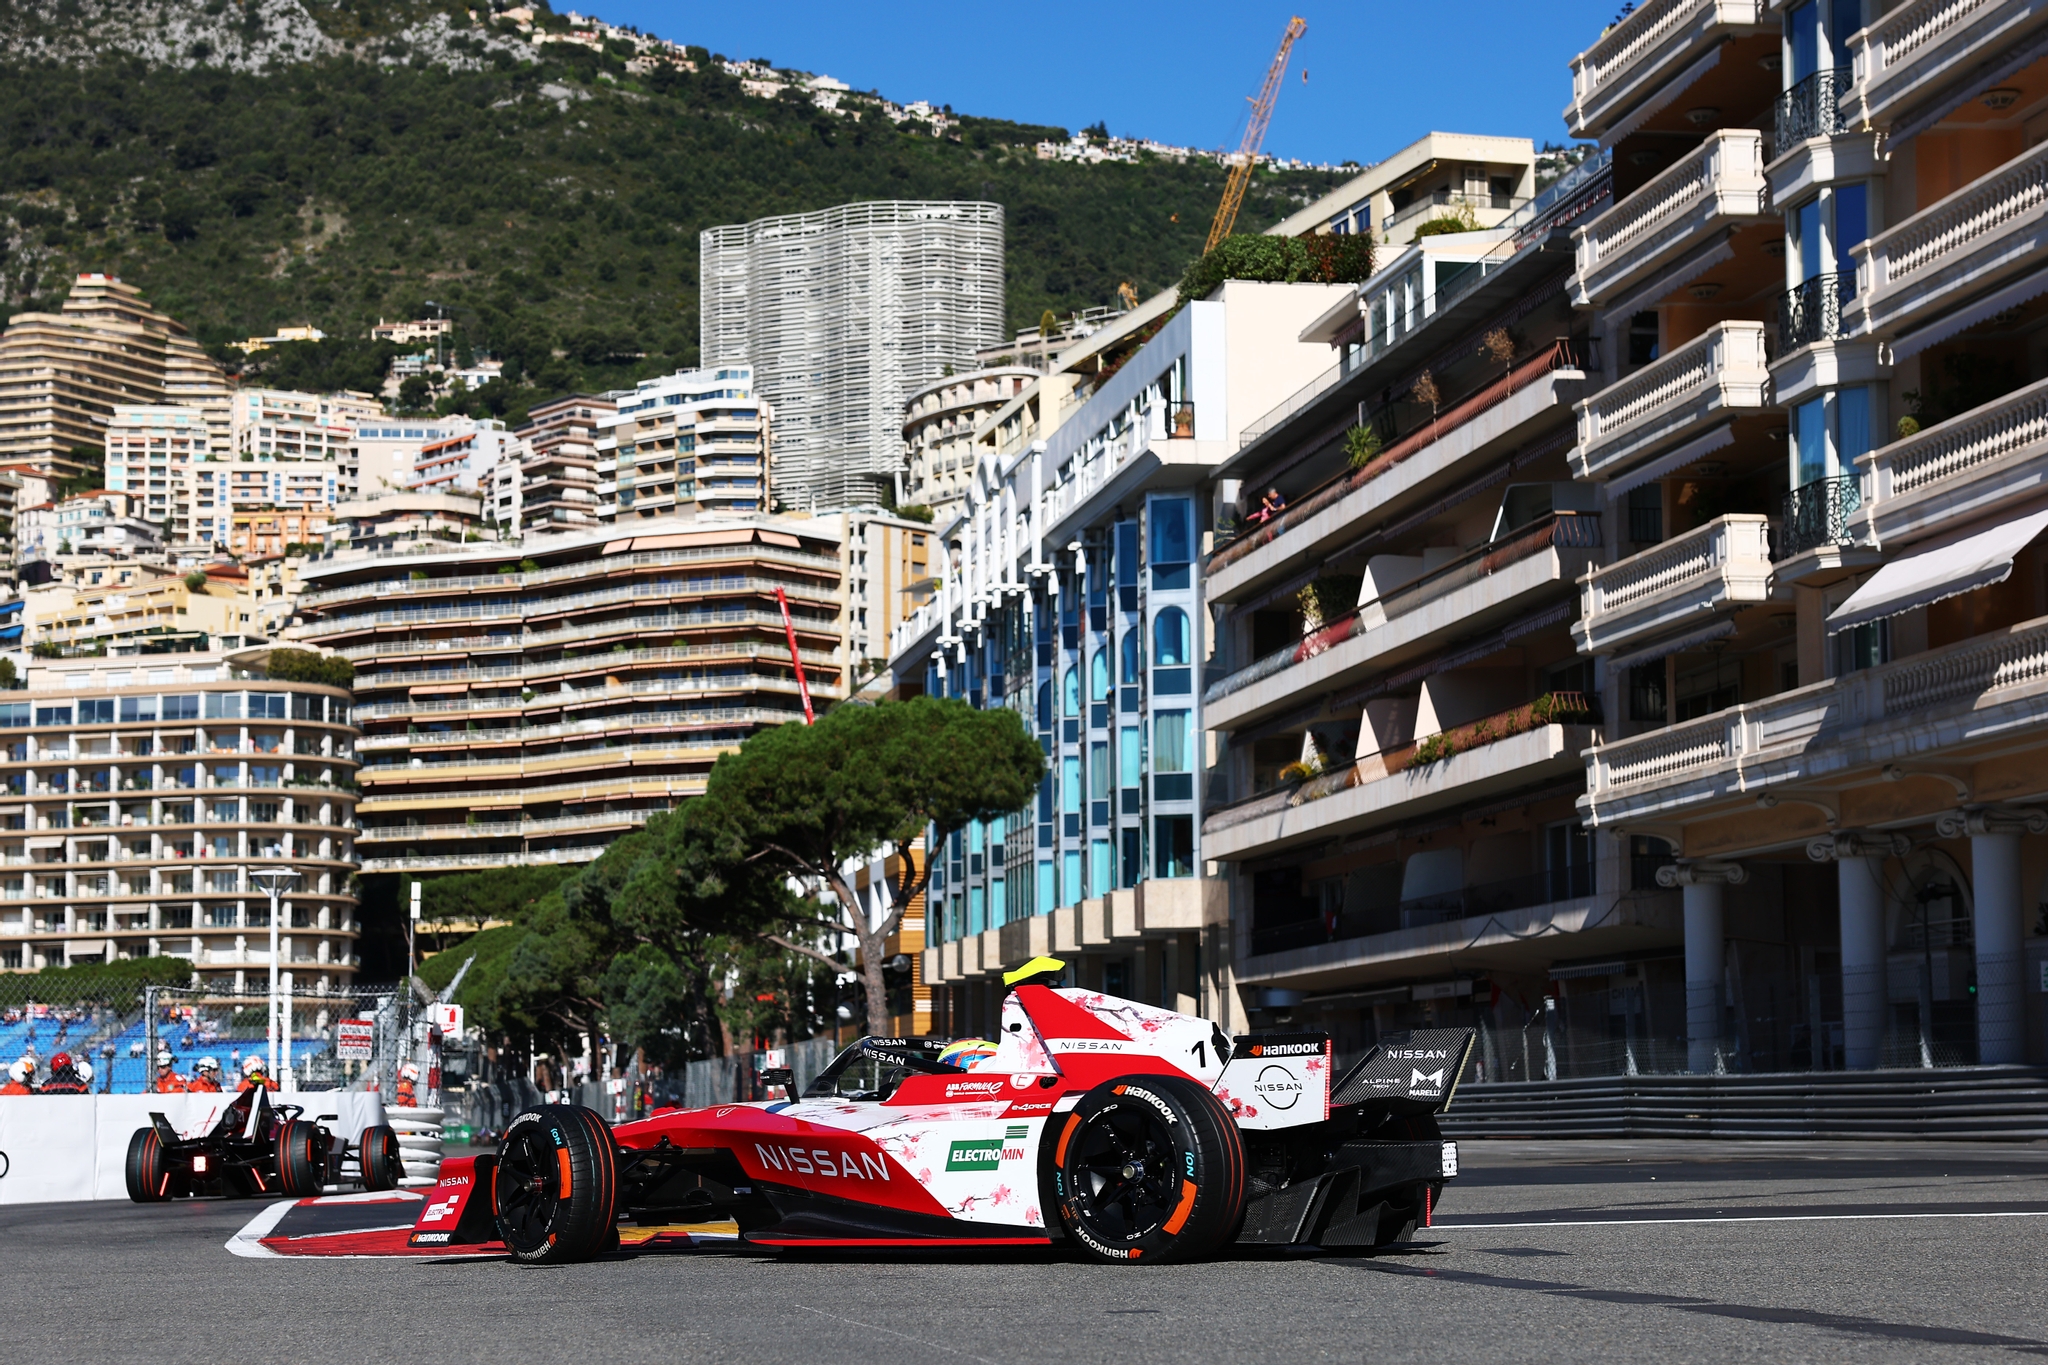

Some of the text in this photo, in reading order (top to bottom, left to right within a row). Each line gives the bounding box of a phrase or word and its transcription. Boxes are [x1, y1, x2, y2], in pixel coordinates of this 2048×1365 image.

[871, 1038, 907, 1047] NISSAN
[1060, 1041, 1123, 1051] NISSAN
[862, 1047, 906, 1066] NISSAN
[1191, 1040, 1206, 1068] 1
[1387, 1050, 1447, 1059] NISSAN
[946, 1083, 960, 1091] ABB
[959, 1082, 993, 1091] FORMULA
[1254, 1083, 1303, 1092] NISSAN
[1409, 1089, 1441, 1097] MARELLI
[951, 1148, 1025, 1162] ELECTROMIN
[754, 1143, 891, 1181] NISSAN
[439, 1176, 469, 1188] NISSAN
